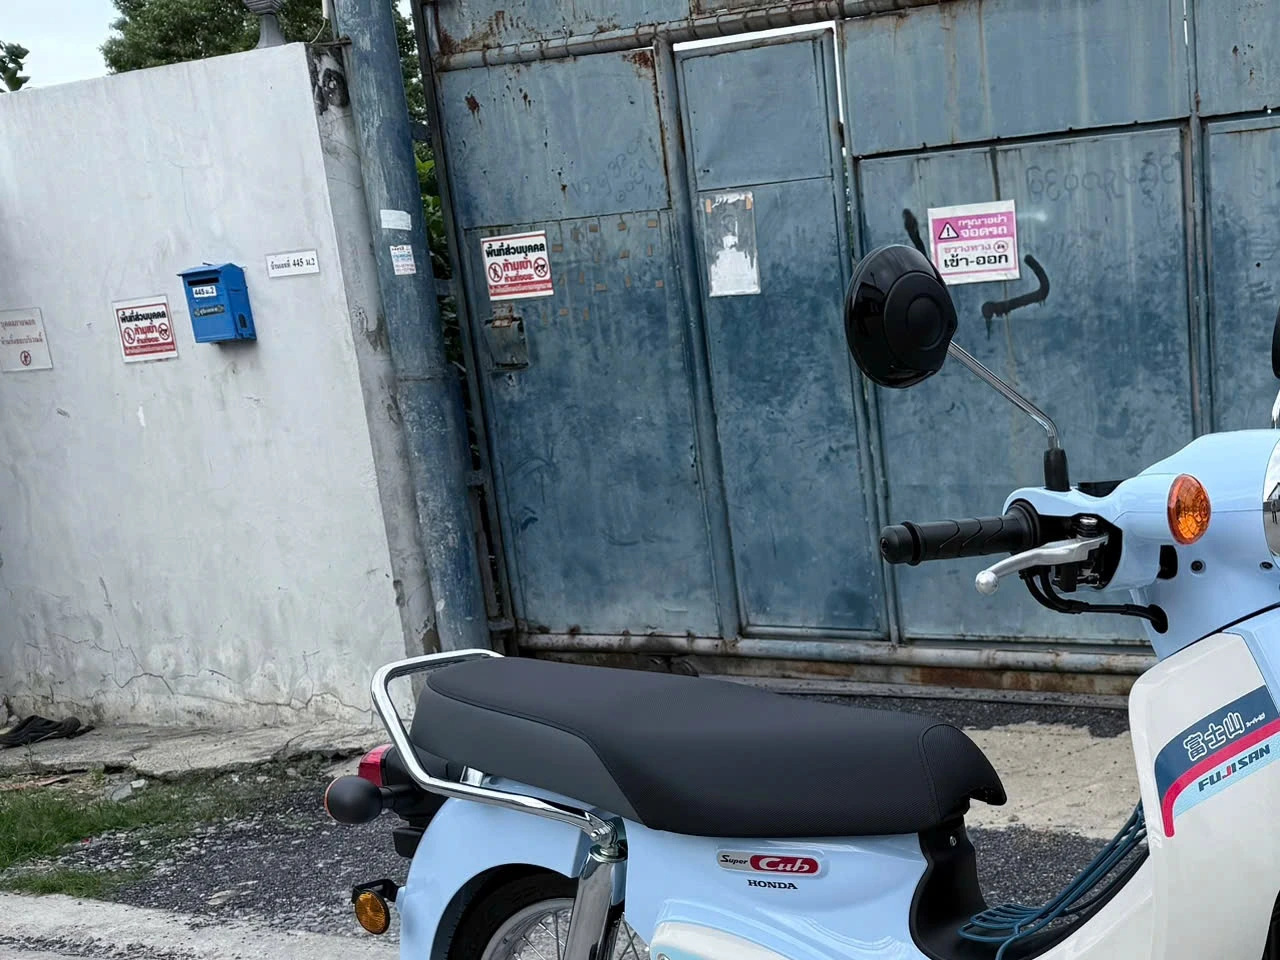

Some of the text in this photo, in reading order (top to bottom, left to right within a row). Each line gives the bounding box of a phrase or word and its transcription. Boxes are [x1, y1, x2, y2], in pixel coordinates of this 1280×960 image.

[958, 214, 1008, 228] กรุณาอย่า
[960, 225, 1007, 238] จอดรถ
[485, 242, 546, 258] พื้นที่ส่วนบุคคล
[944, 243, 991, 255] ขวางทาง
[293, 258, 304, 267] 445
[502, 257, 533, 273] ห้ามเข้า
[944, 253, 1009, 268] เข้า-ออก
[1183, 712, 1245, 762] 富士山
[1198, 744, 1271, 792] FUJISAN
[720, 855, 810, 871] Super Cub
[747, 880, 798, 890] HONDA
